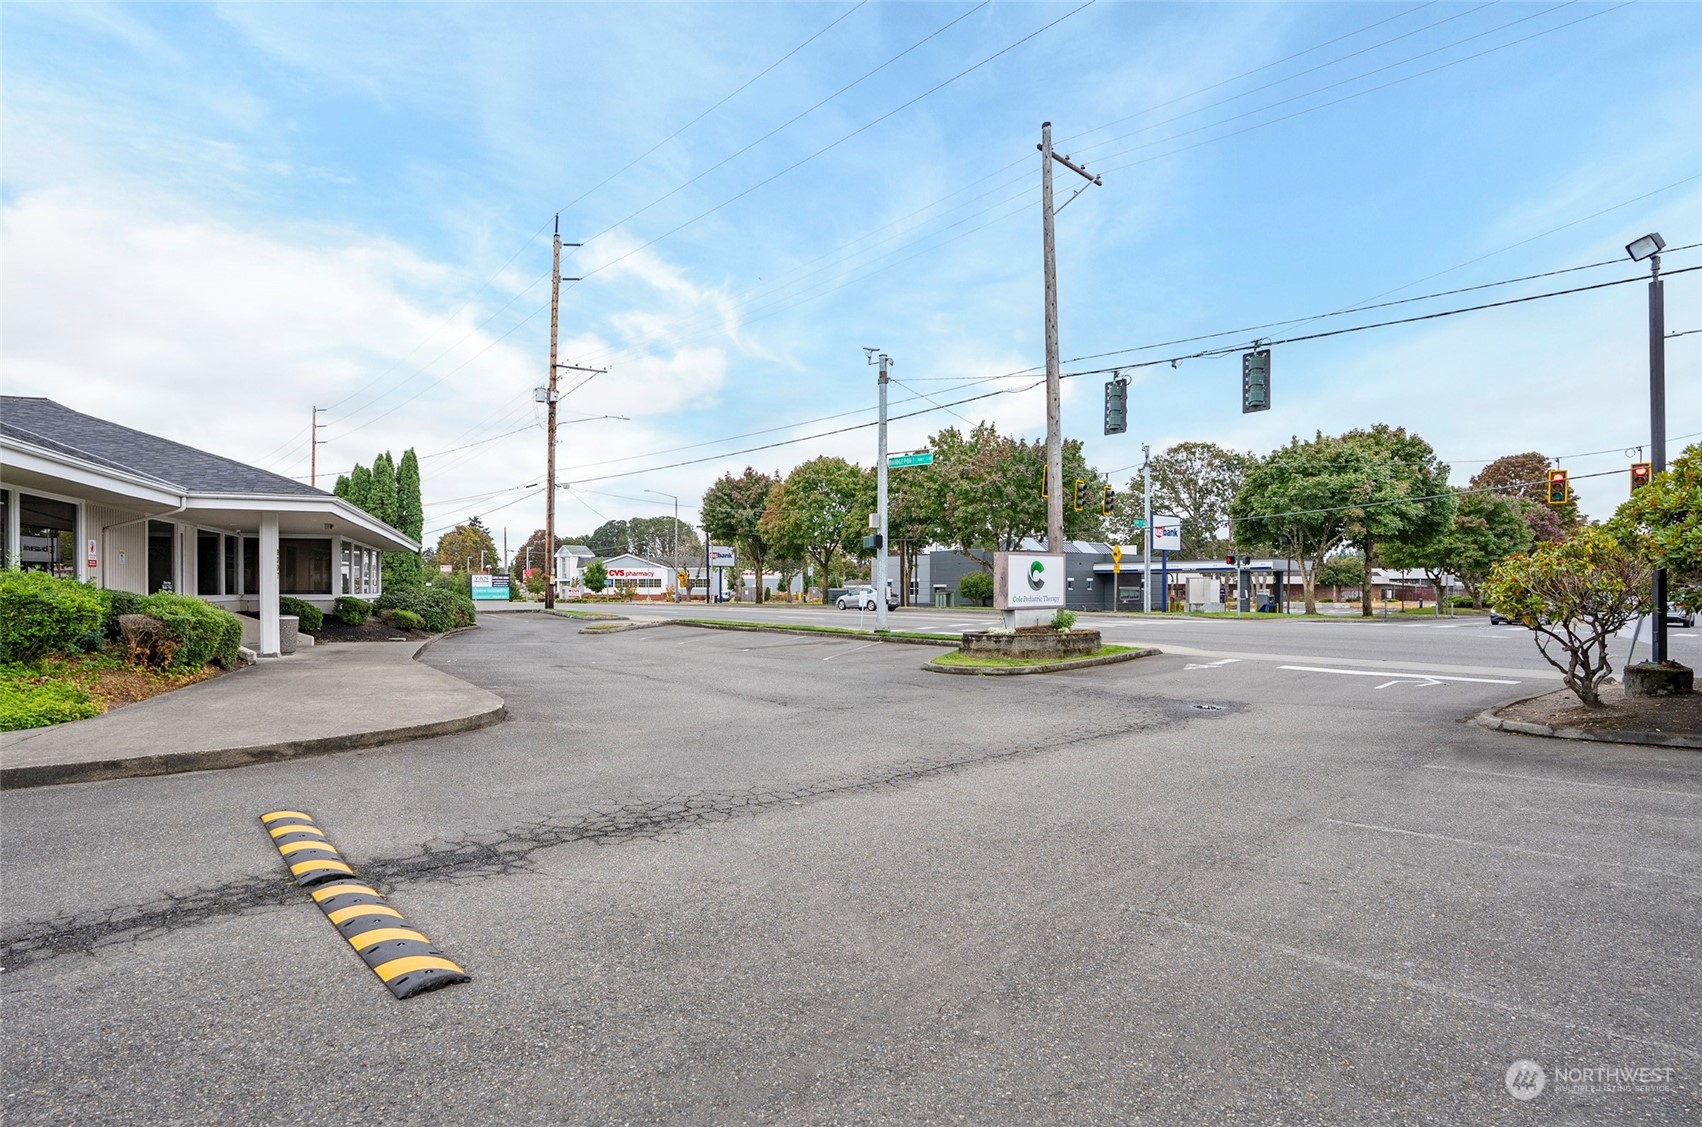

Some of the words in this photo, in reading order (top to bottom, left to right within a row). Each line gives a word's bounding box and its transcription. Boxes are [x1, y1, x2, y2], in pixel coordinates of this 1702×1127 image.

[609, 569, 625, 577] CVS
[625, 570, 655, 578] pharmacy
[1012, 595, 1023, 603] Cole
[1023, 595, 1043, 603] Pediatric
[1043, 595, 1060, 603] Therapy
